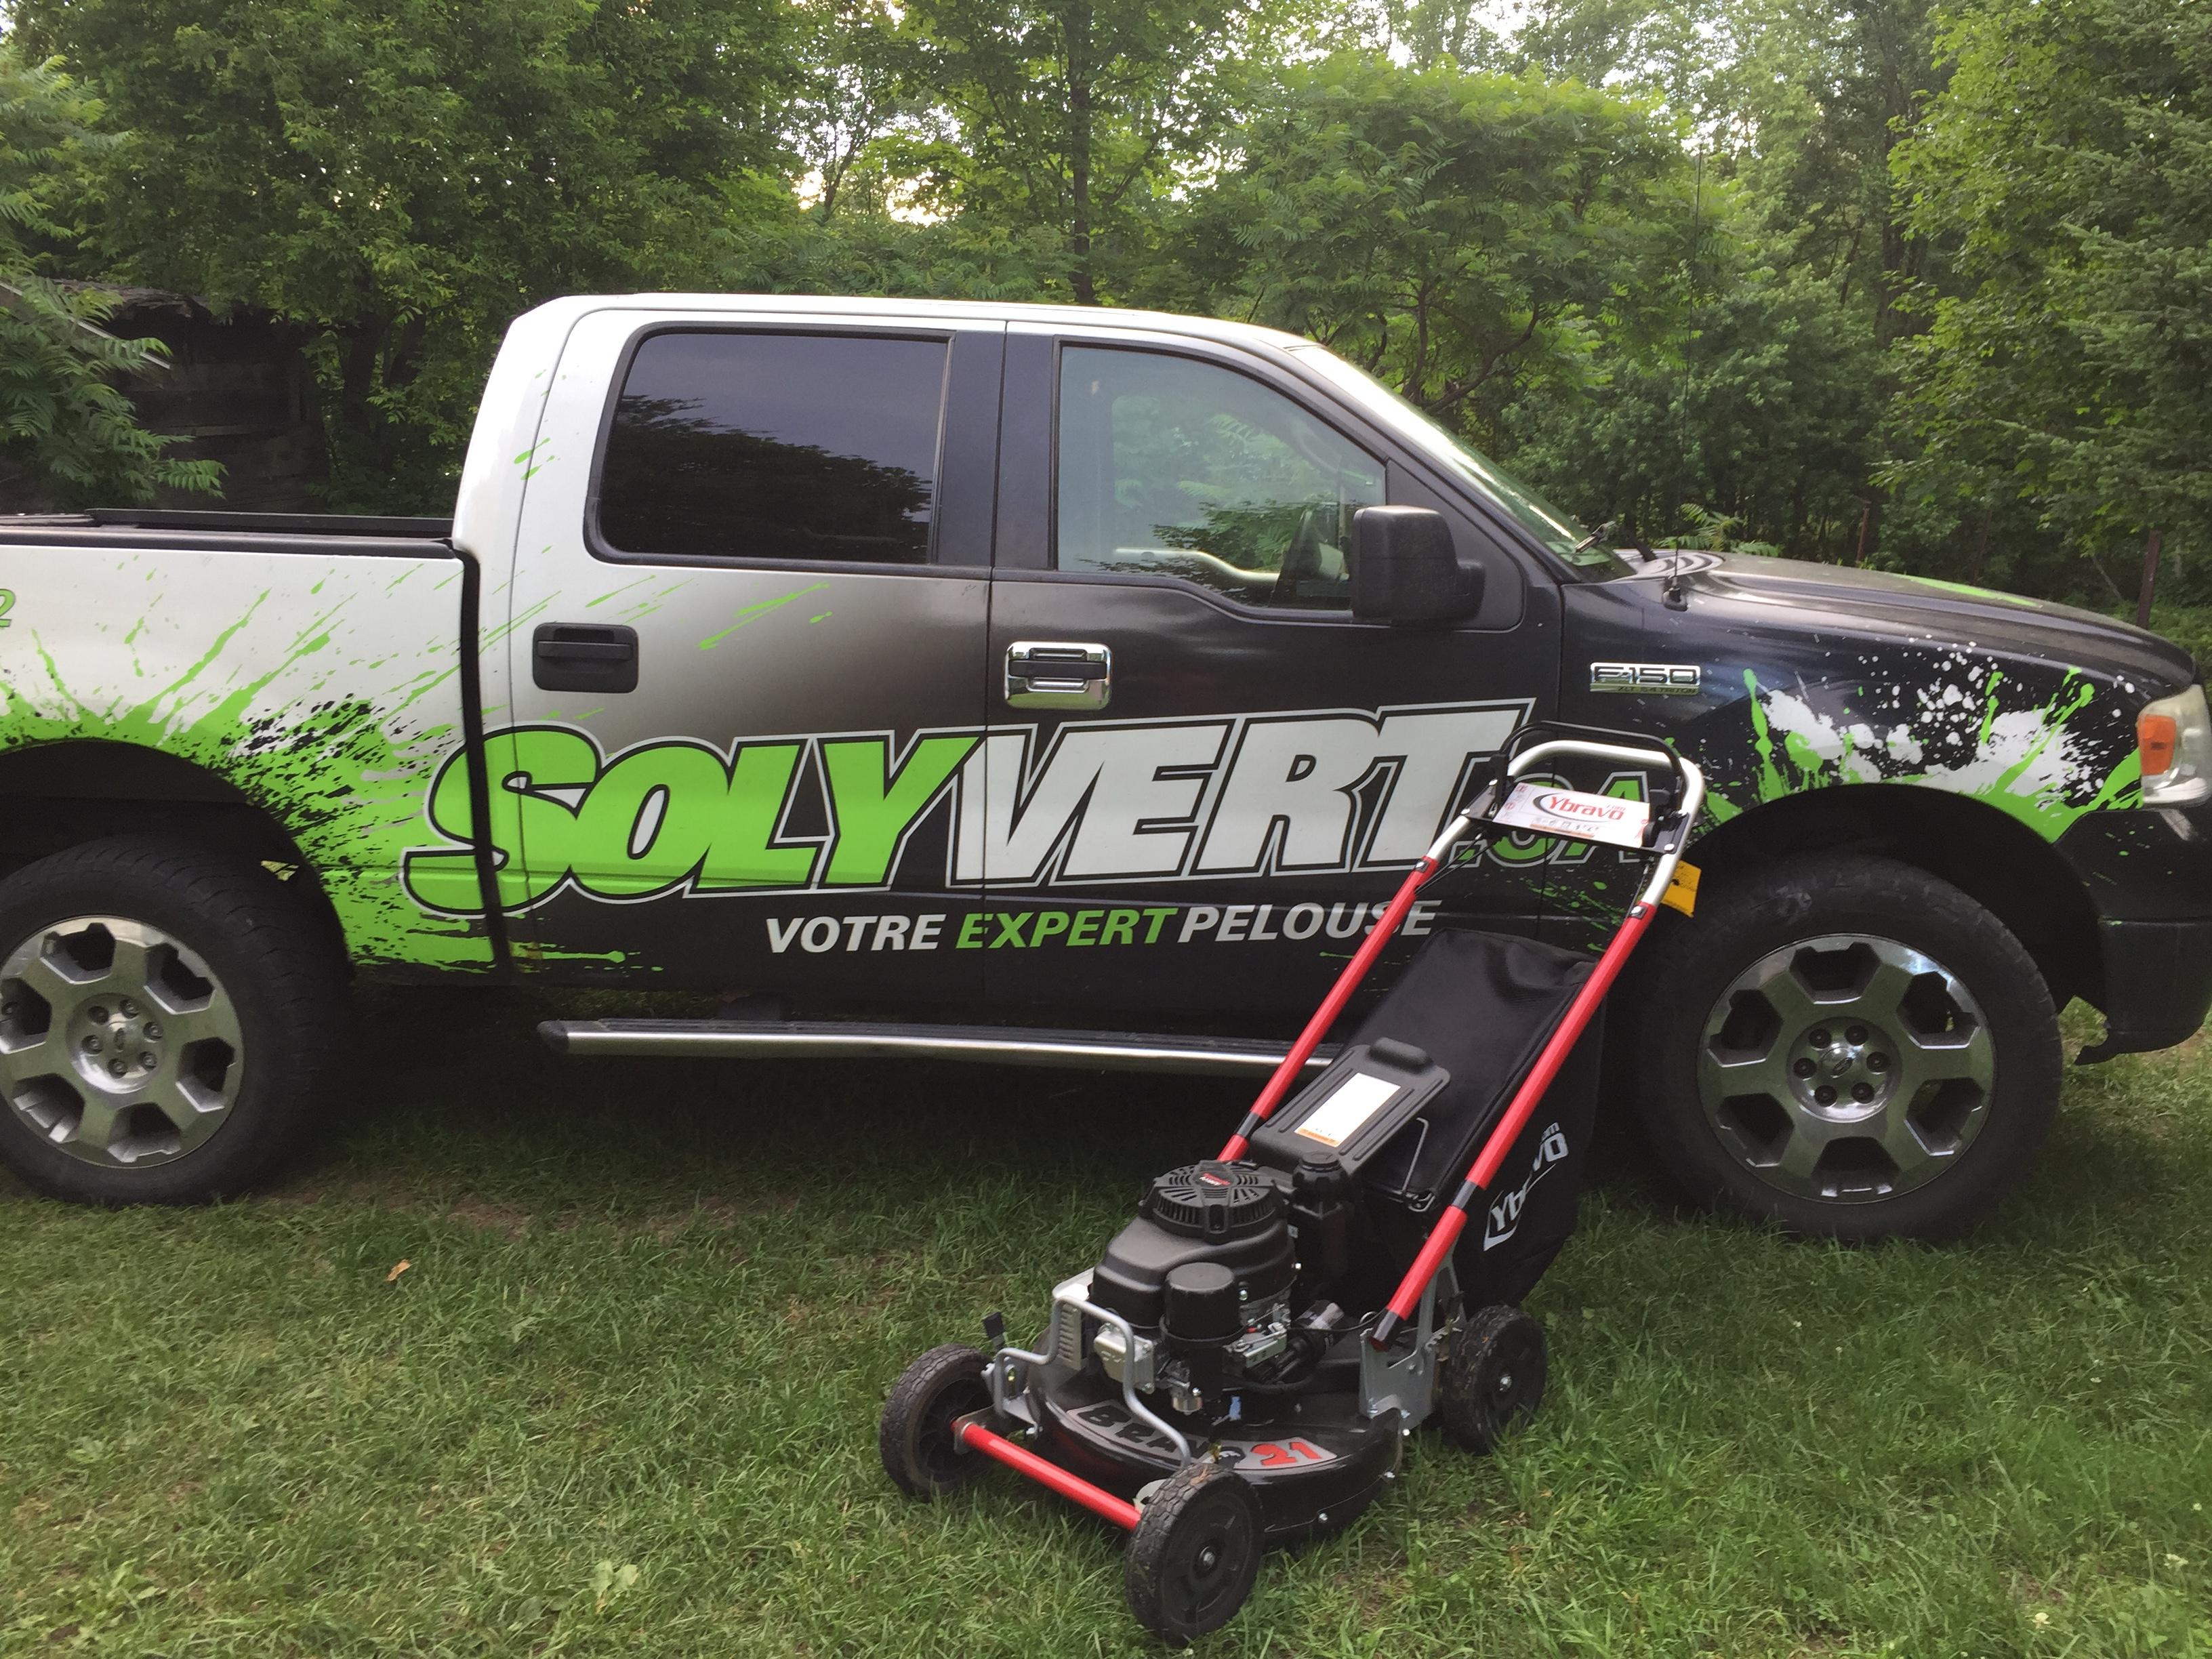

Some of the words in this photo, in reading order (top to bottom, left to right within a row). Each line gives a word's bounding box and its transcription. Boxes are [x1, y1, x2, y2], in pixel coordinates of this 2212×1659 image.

[1548, 796, 1626, 820] Ybravo
[765, 914, 947, 954] VOTRE
[955, 907, 1179, 949] EXPERT
[1491, 1132, 1569, 1232] Ybvo
[1251, 1441, 1324, 1467] 21
